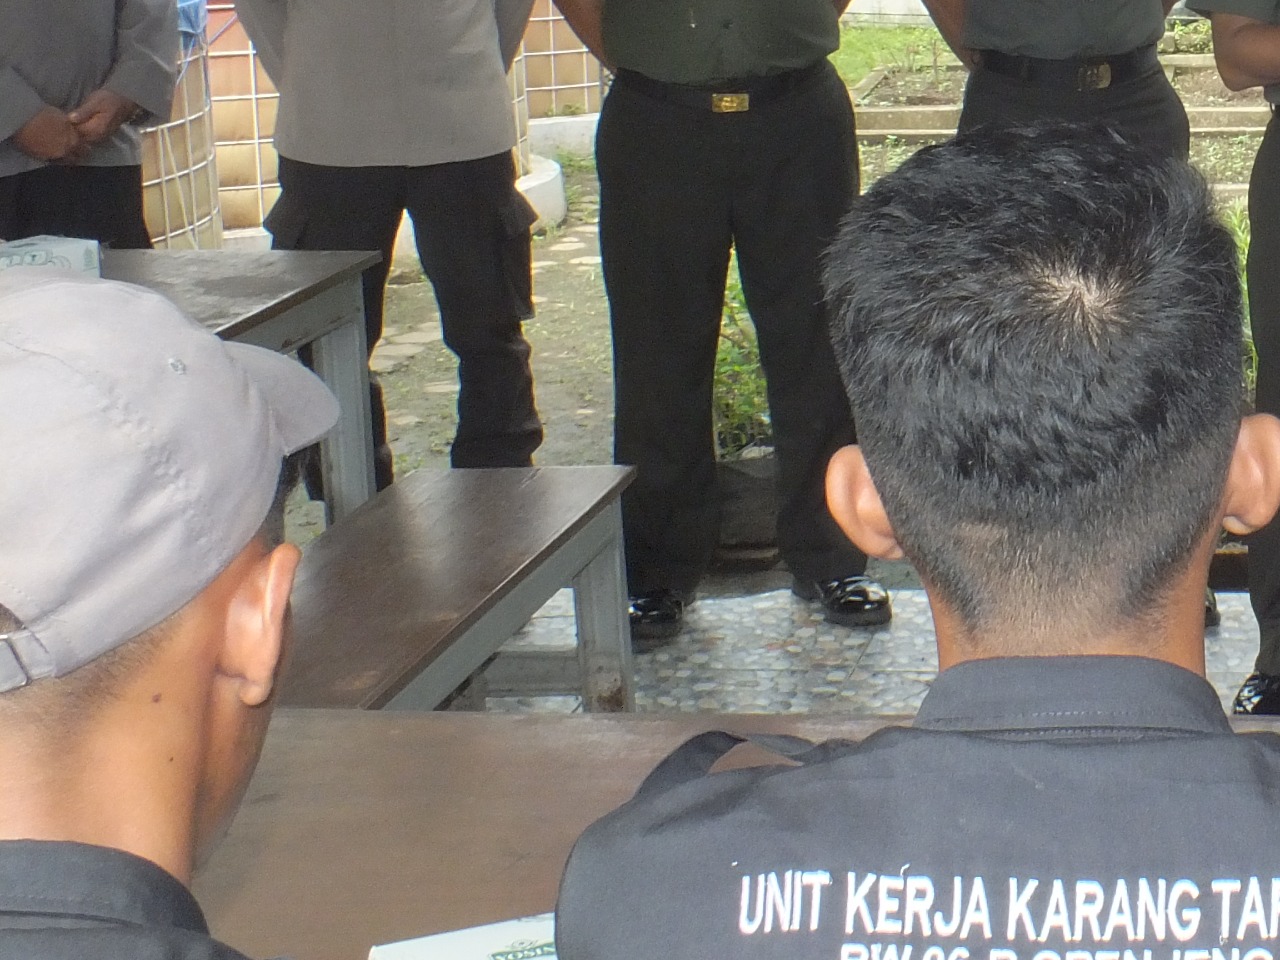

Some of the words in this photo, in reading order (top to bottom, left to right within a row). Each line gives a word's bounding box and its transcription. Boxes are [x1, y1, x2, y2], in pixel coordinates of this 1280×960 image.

[738, 869, 832, 935] UNIT
[844, 870, 993, 940] KERJA
[1006, 875, 1201, 943] KARANG
